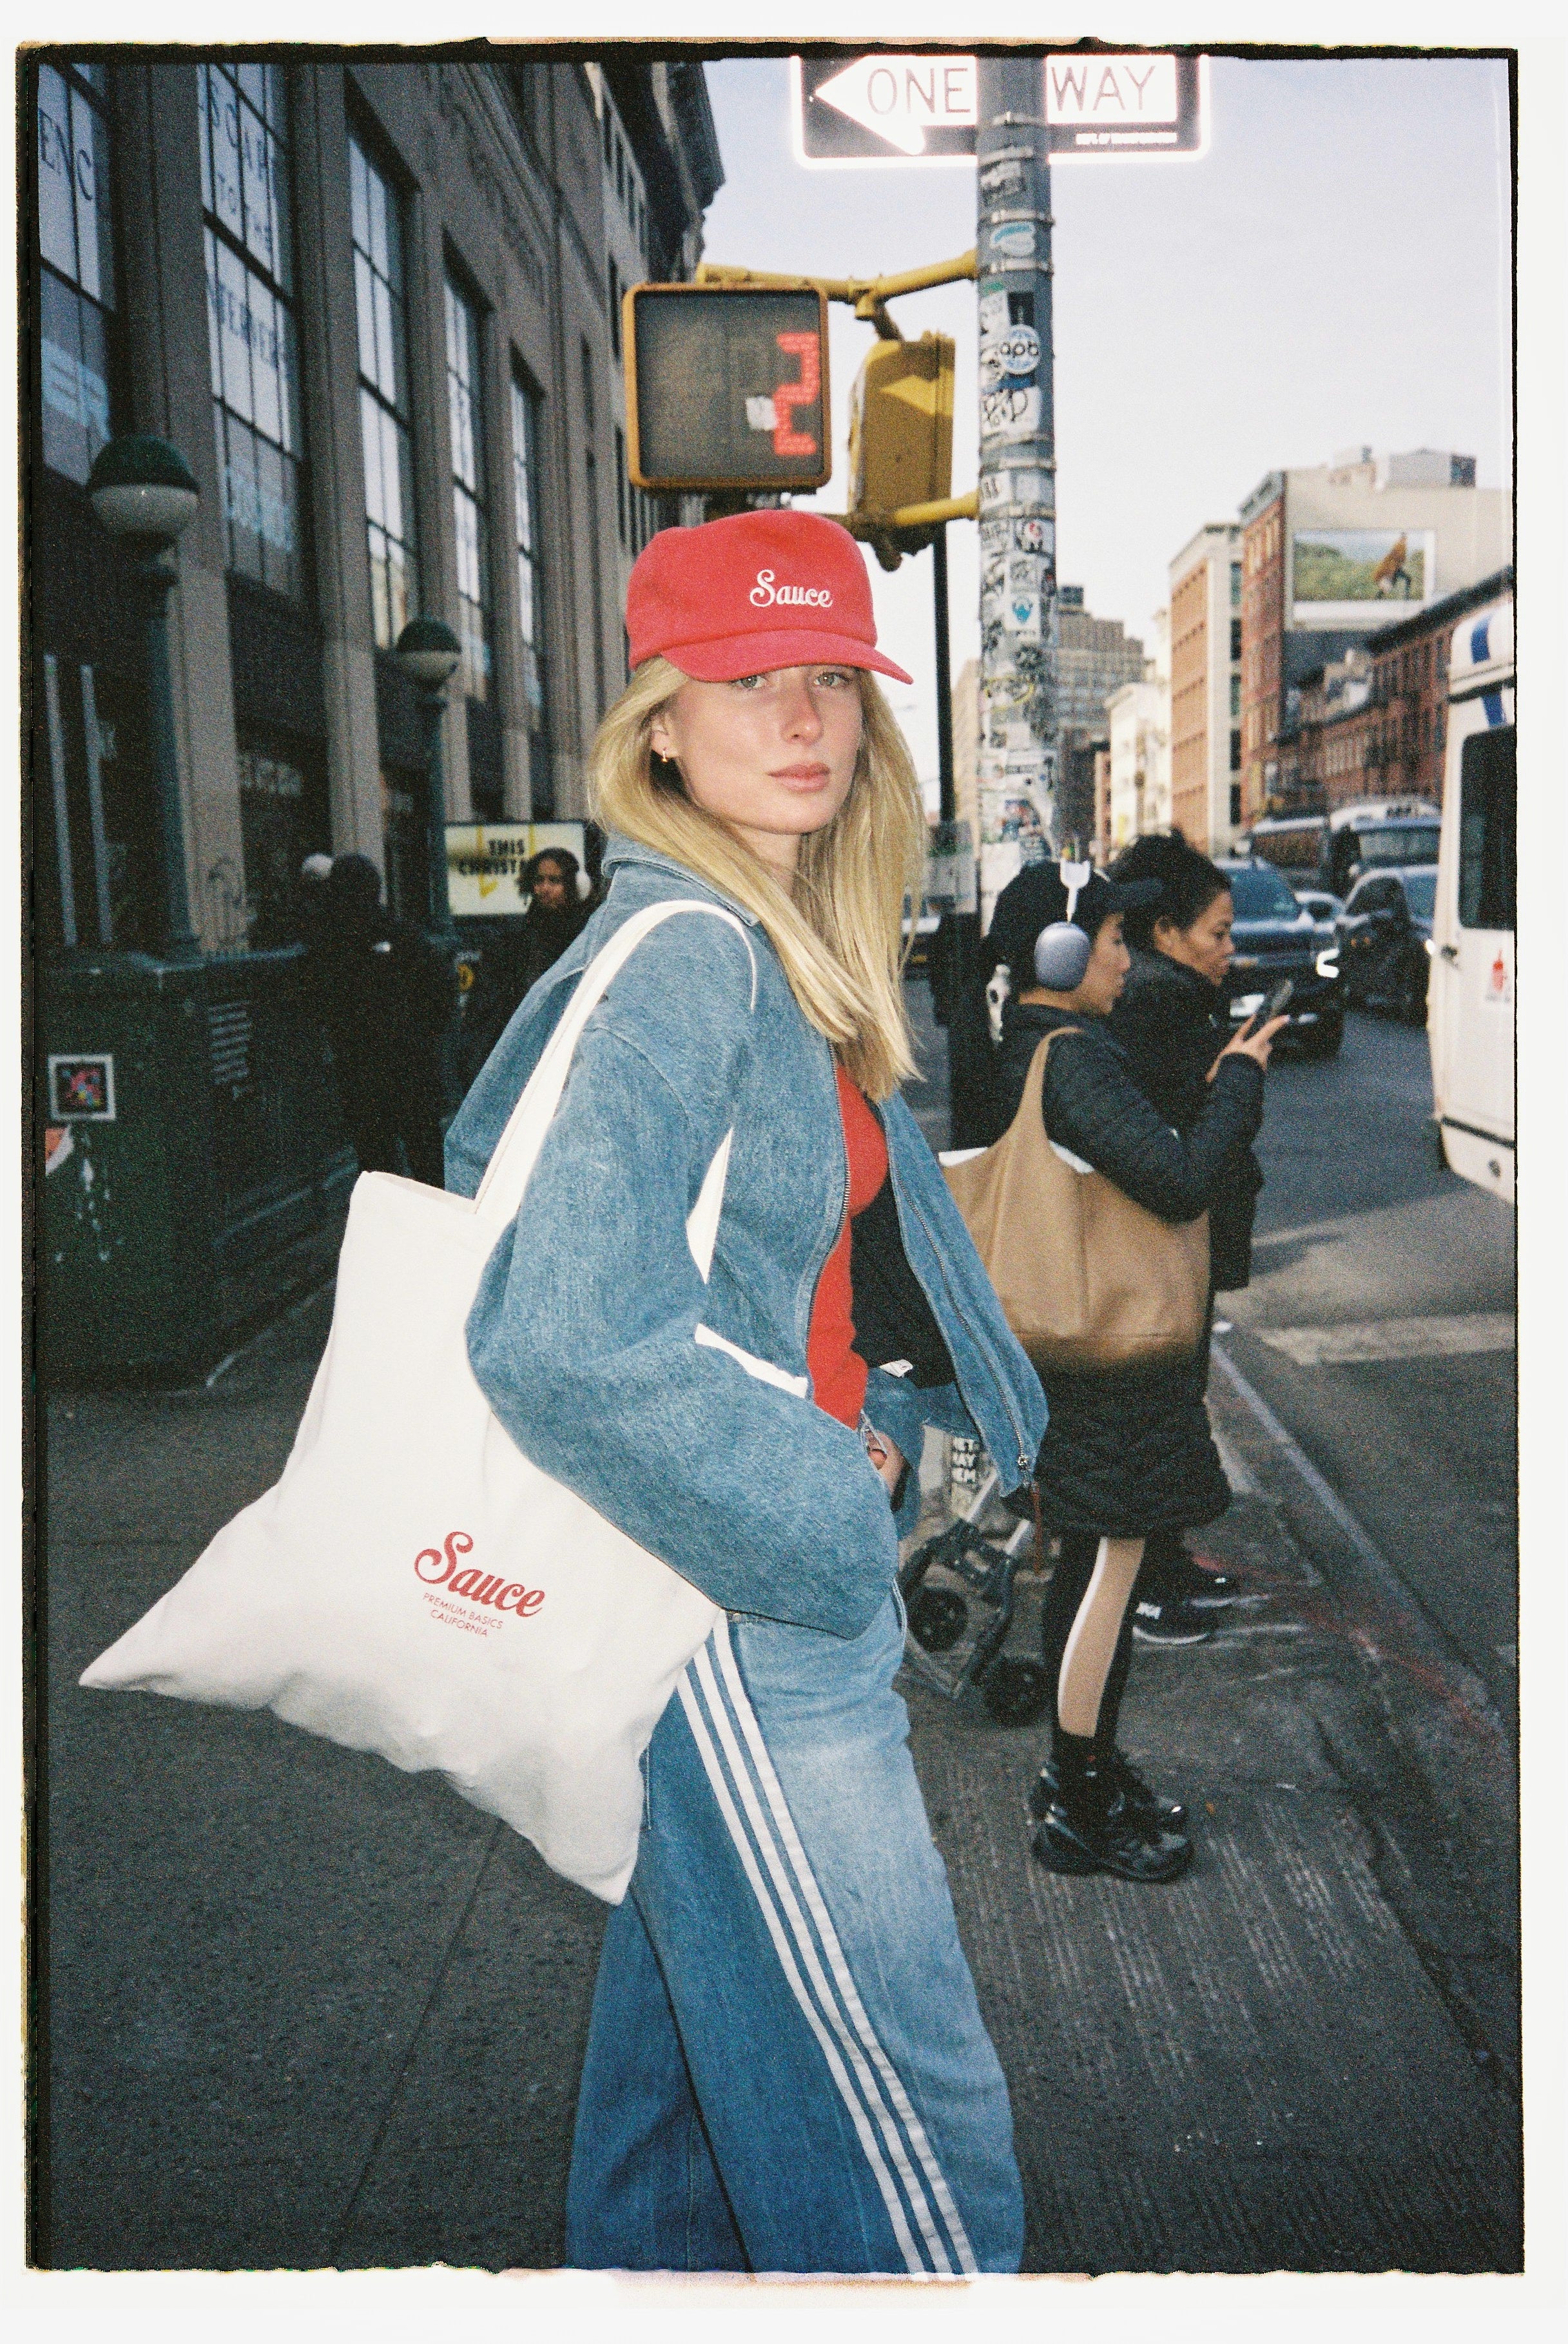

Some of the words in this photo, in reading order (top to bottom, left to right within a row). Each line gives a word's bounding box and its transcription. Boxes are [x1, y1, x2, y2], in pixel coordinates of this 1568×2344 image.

[866, 67, 971, 115] ONE
[1050, 65, 1156, 113] WAY
[773, 332, 820, 455] 2
[749, 569, 833, 608] Sauce
[488, 838, 525, 855] THIS
[414, 1531, 545, 1618] Sauce
[423, 1593, 467, 1618] PREMIUM
[469, 1611, 504, 1629] BASICS
[430, 1609, 489, 1637] CALIFORNIA
